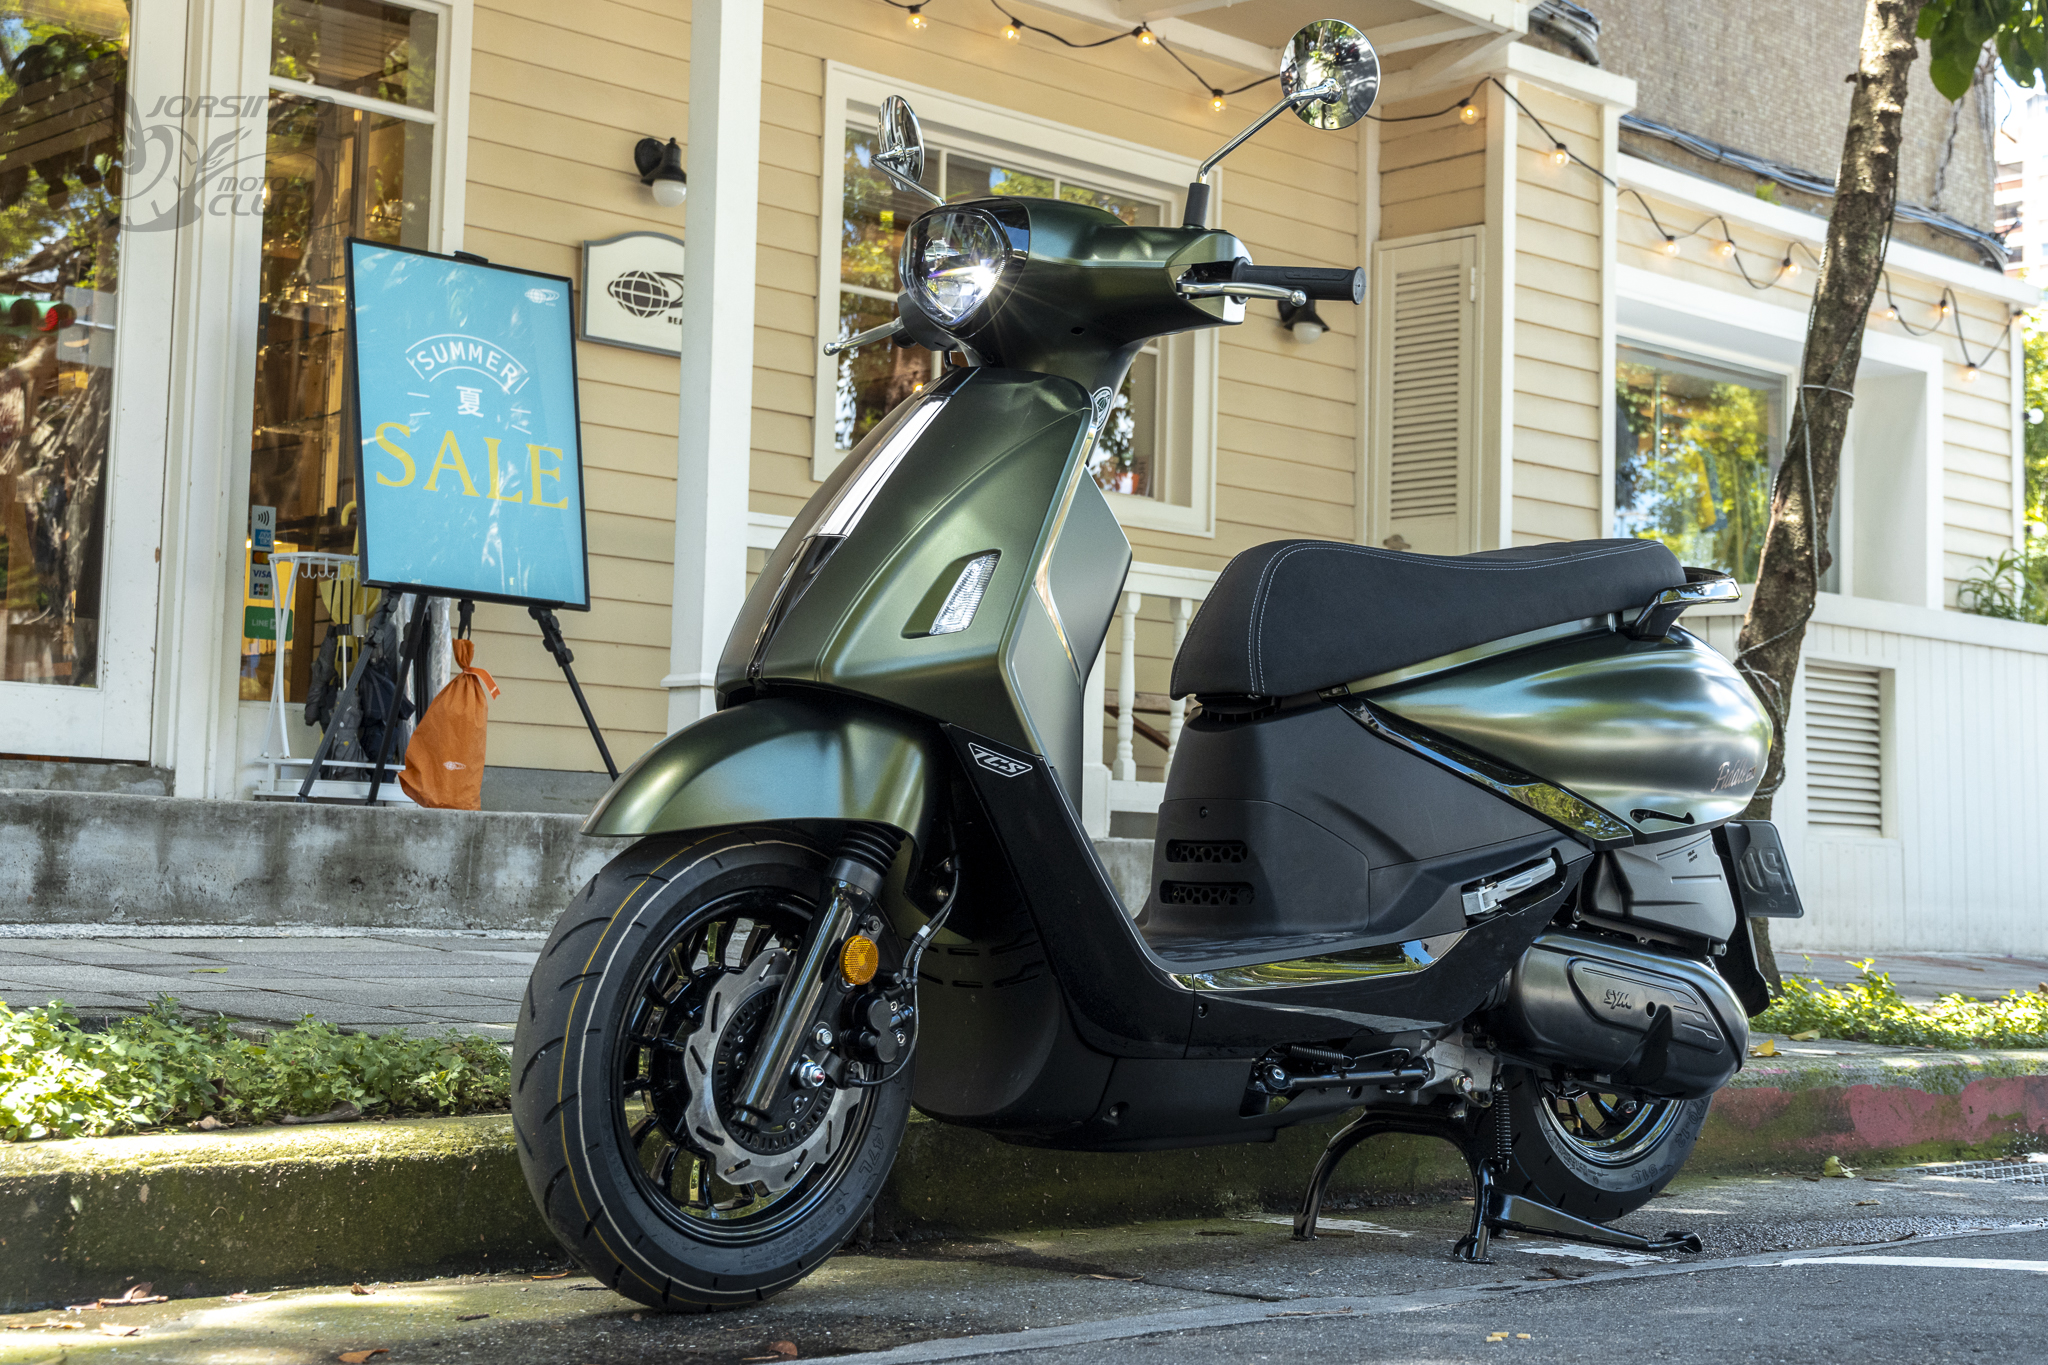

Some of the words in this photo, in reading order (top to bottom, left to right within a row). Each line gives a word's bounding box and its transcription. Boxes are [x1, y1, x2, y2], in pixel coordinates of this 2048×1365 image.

[417, 341, 518, 386] SUMMER
[456, 385, 484, 418] 夏
[375, 422, 568, 509] SALE
[253, 569, 272, 578] VISA
[252, 618, 269, 627] LINE
[1603, 988, 1632, 1010] SYM
